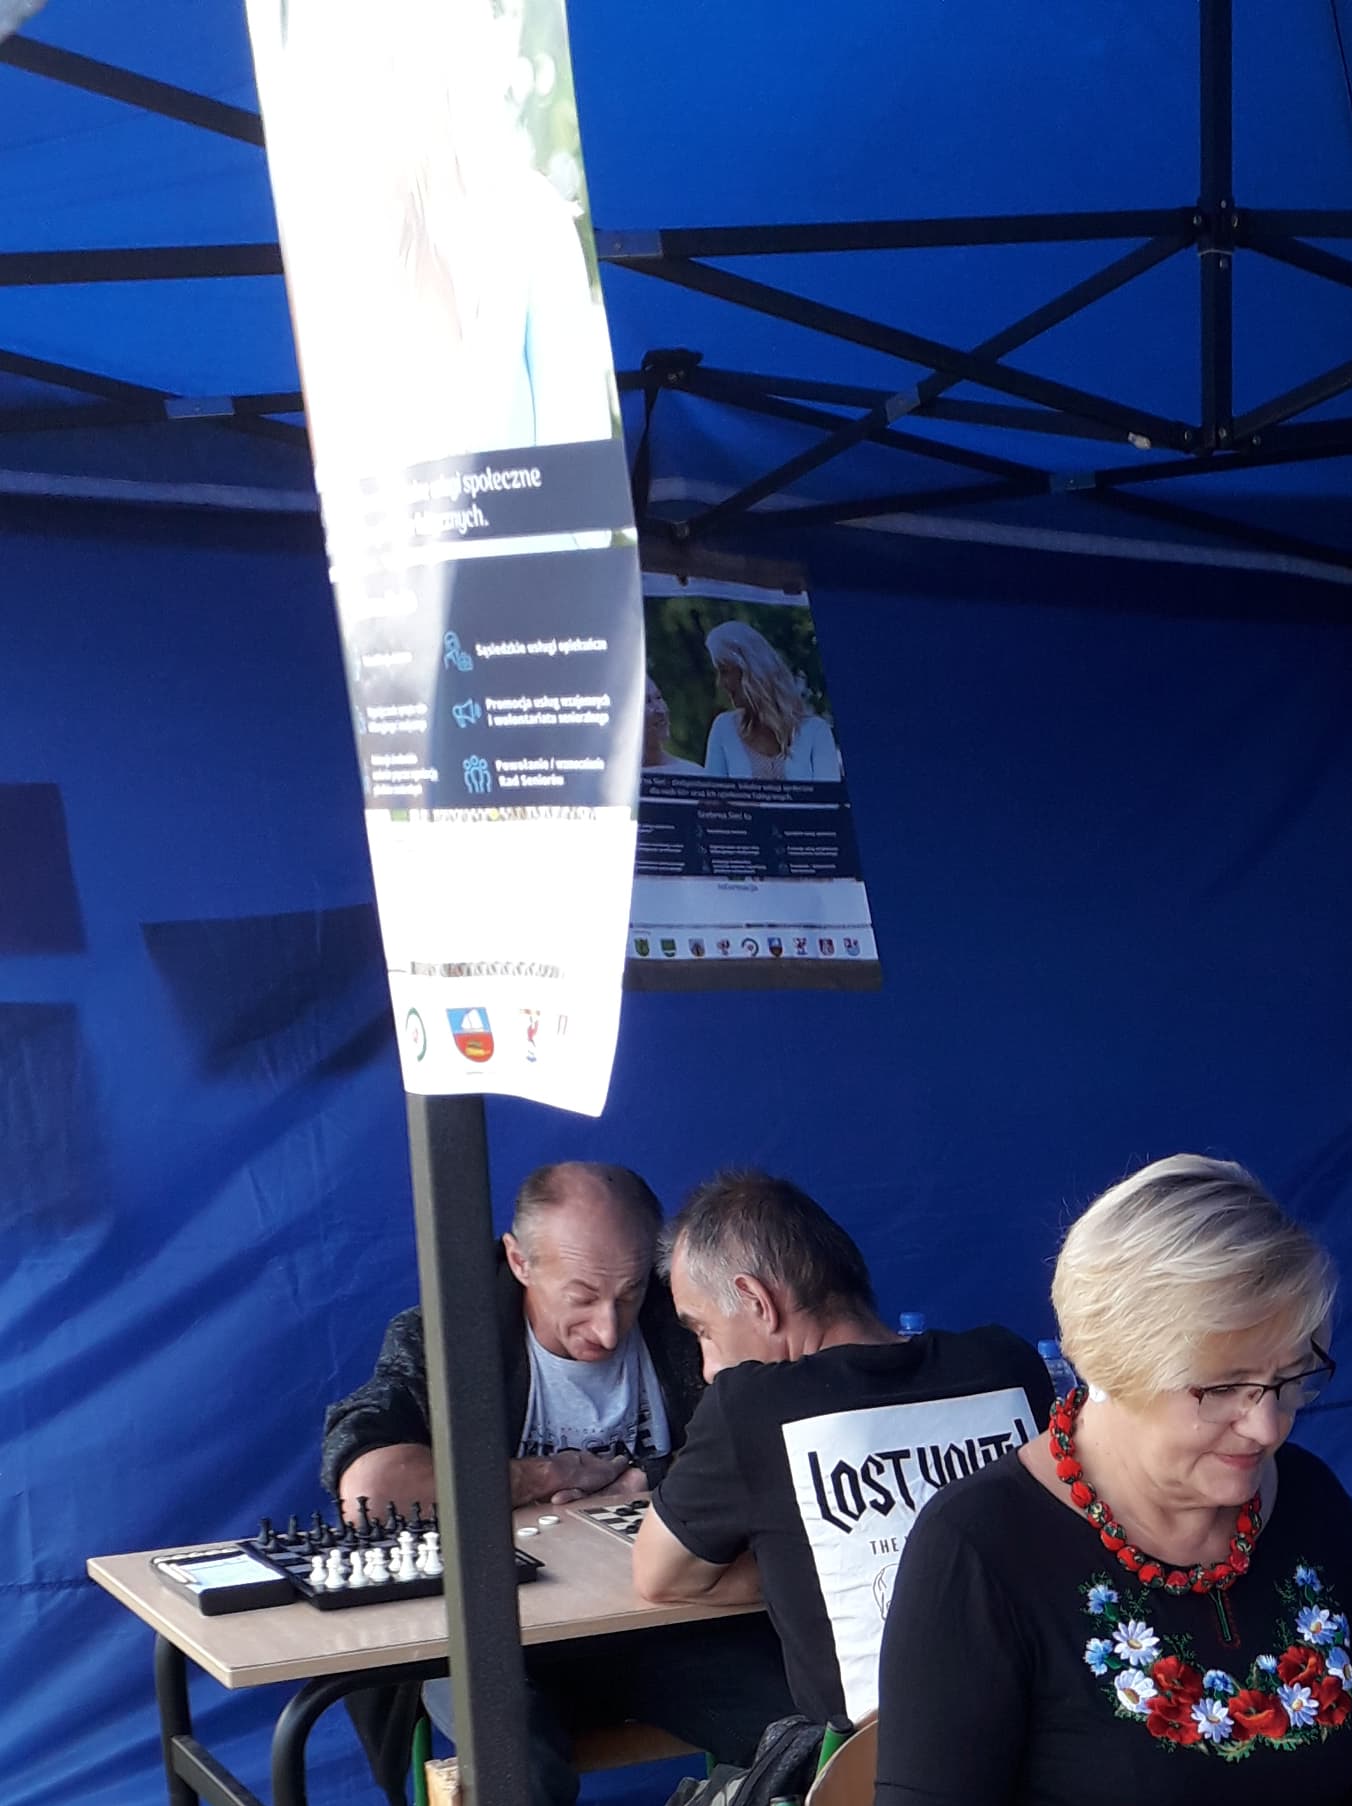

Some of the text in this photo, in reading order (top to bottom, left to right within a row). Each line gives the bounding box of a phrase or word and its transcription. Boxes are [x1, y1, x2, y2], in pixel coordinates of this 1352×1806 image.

[463, 467, 542, 499] społeczne
[808, 1449, 916, 1534] LOST
[870, 1537, 899, 1555] THE
